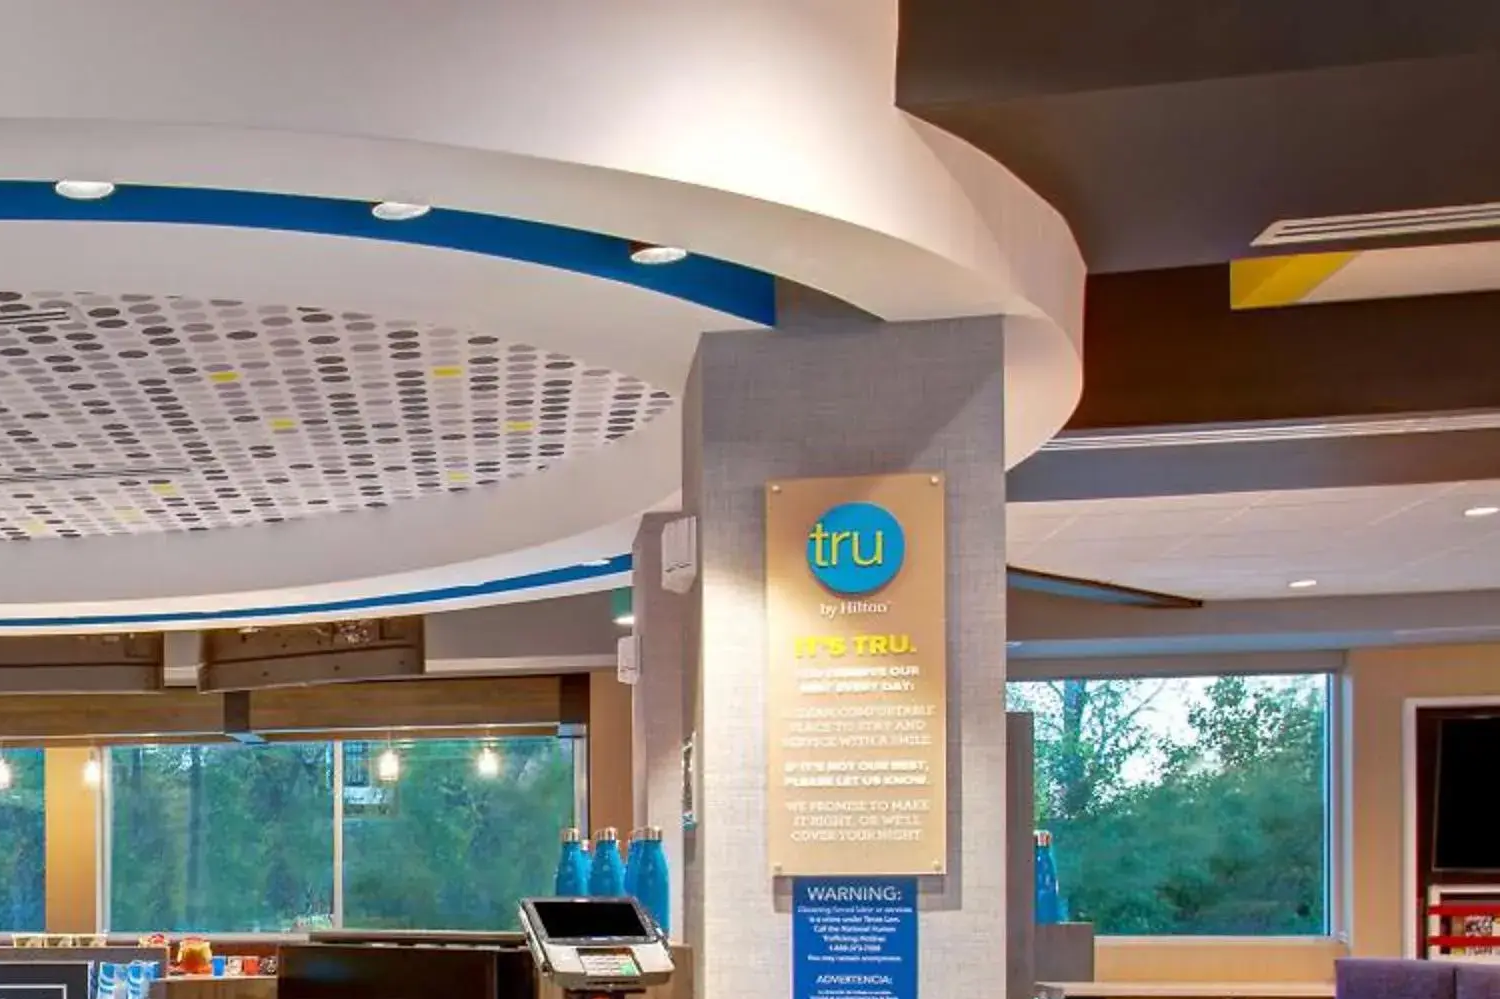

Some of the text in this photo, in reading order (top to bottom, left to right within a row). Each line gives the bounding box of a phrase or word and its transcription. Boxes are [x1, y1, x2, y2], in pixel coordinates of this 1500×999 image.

[808, 523, 884, 567] tru
[820, 601, 888, 619] by Hilton
[794, 634, 918, 658] IT'S TRU.
[807, 886, 902, 901] WARNING:
